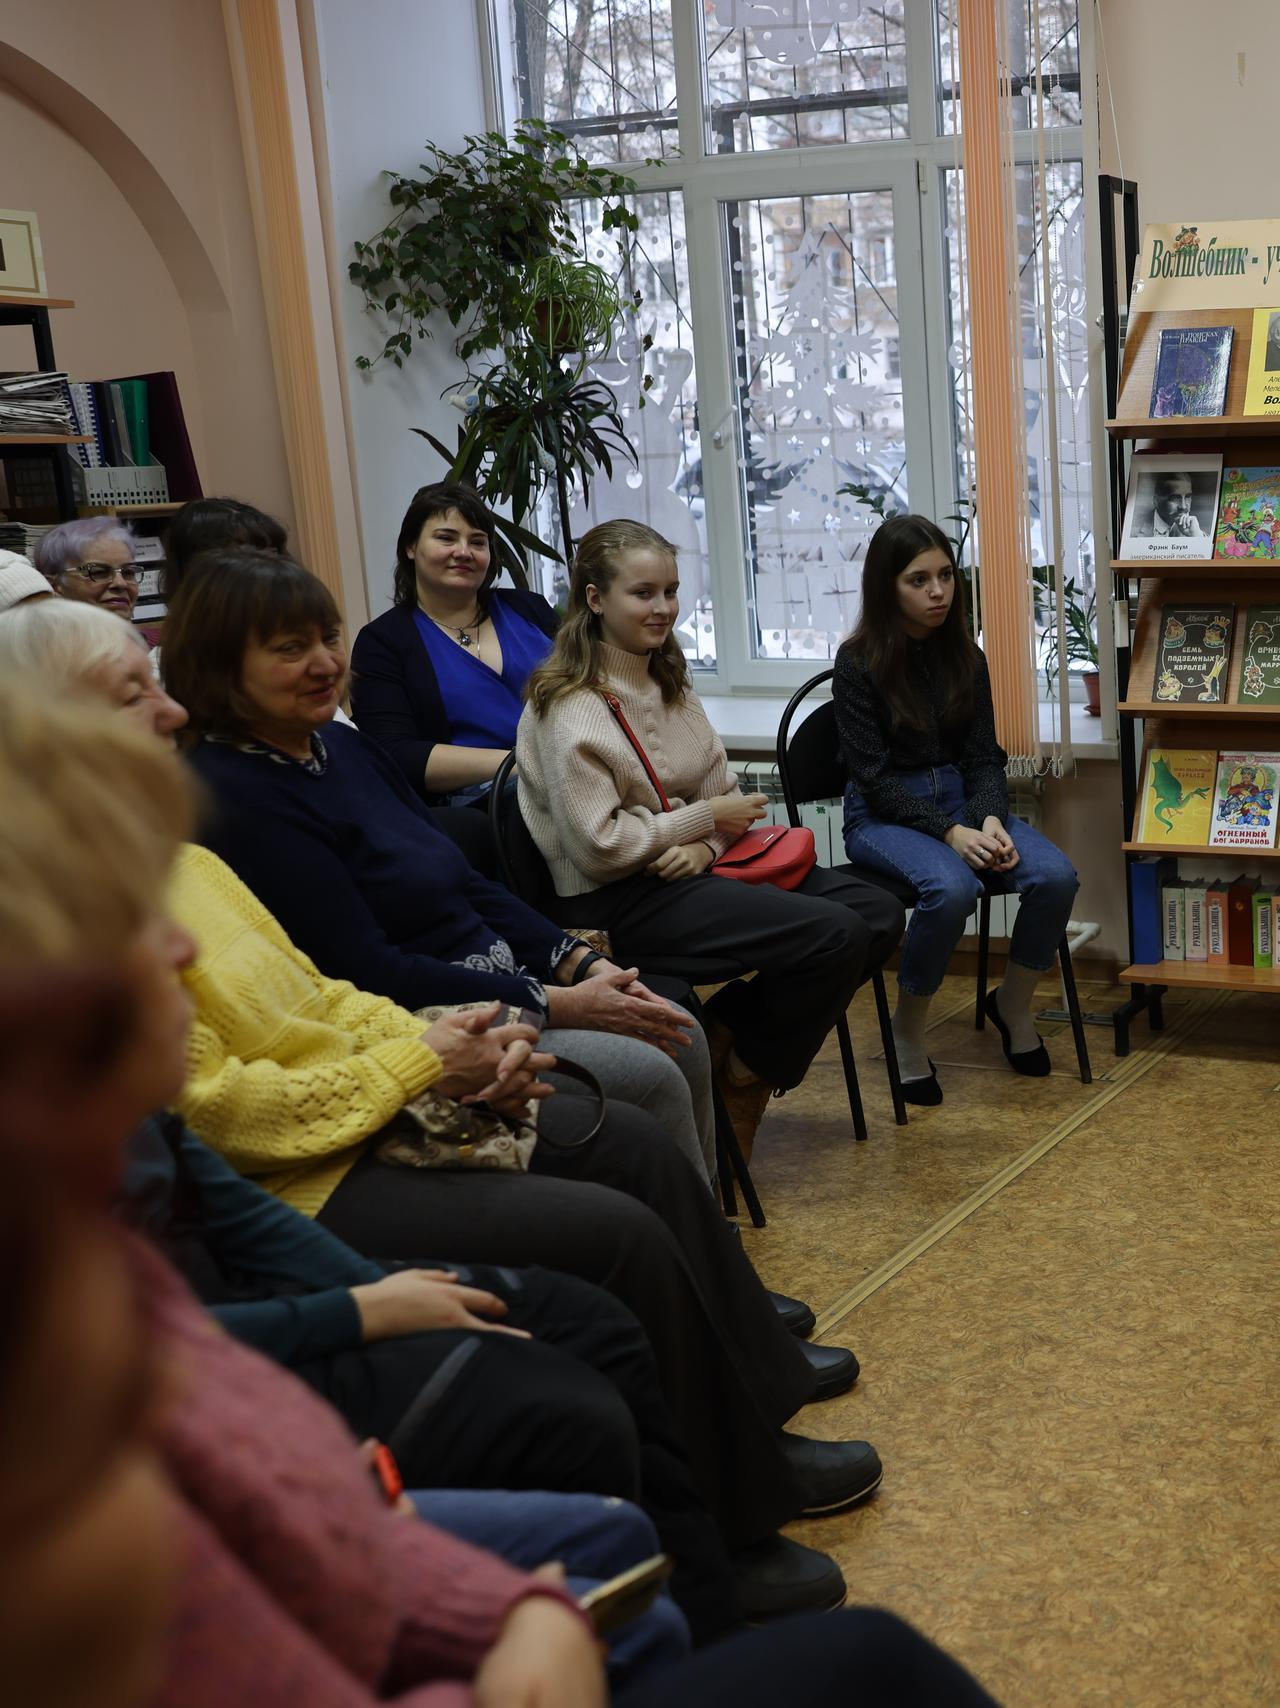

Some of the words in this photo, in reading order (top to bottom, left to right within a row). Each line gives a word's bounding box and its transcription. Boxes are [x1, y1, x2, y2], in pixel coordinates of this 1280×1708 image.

[1149, 237, 1248, 279] Волшебник
[1167, 655, 1215, 663] ПОДЗЕМНЫХ
[1173, 663, 1207, 671] КОРОЛЕЙ
[1217, 829, 1267, 838] ОГНЕННЫЙ
[1192, 900, 1201, 947] РУКОДЕЛЬНИЦА
[1211, 907, 1221, 953] РУКОДЕЛЬНИЦА
[1260, 906, 1269, 954] РУКОДЕЛЬНИЦА
